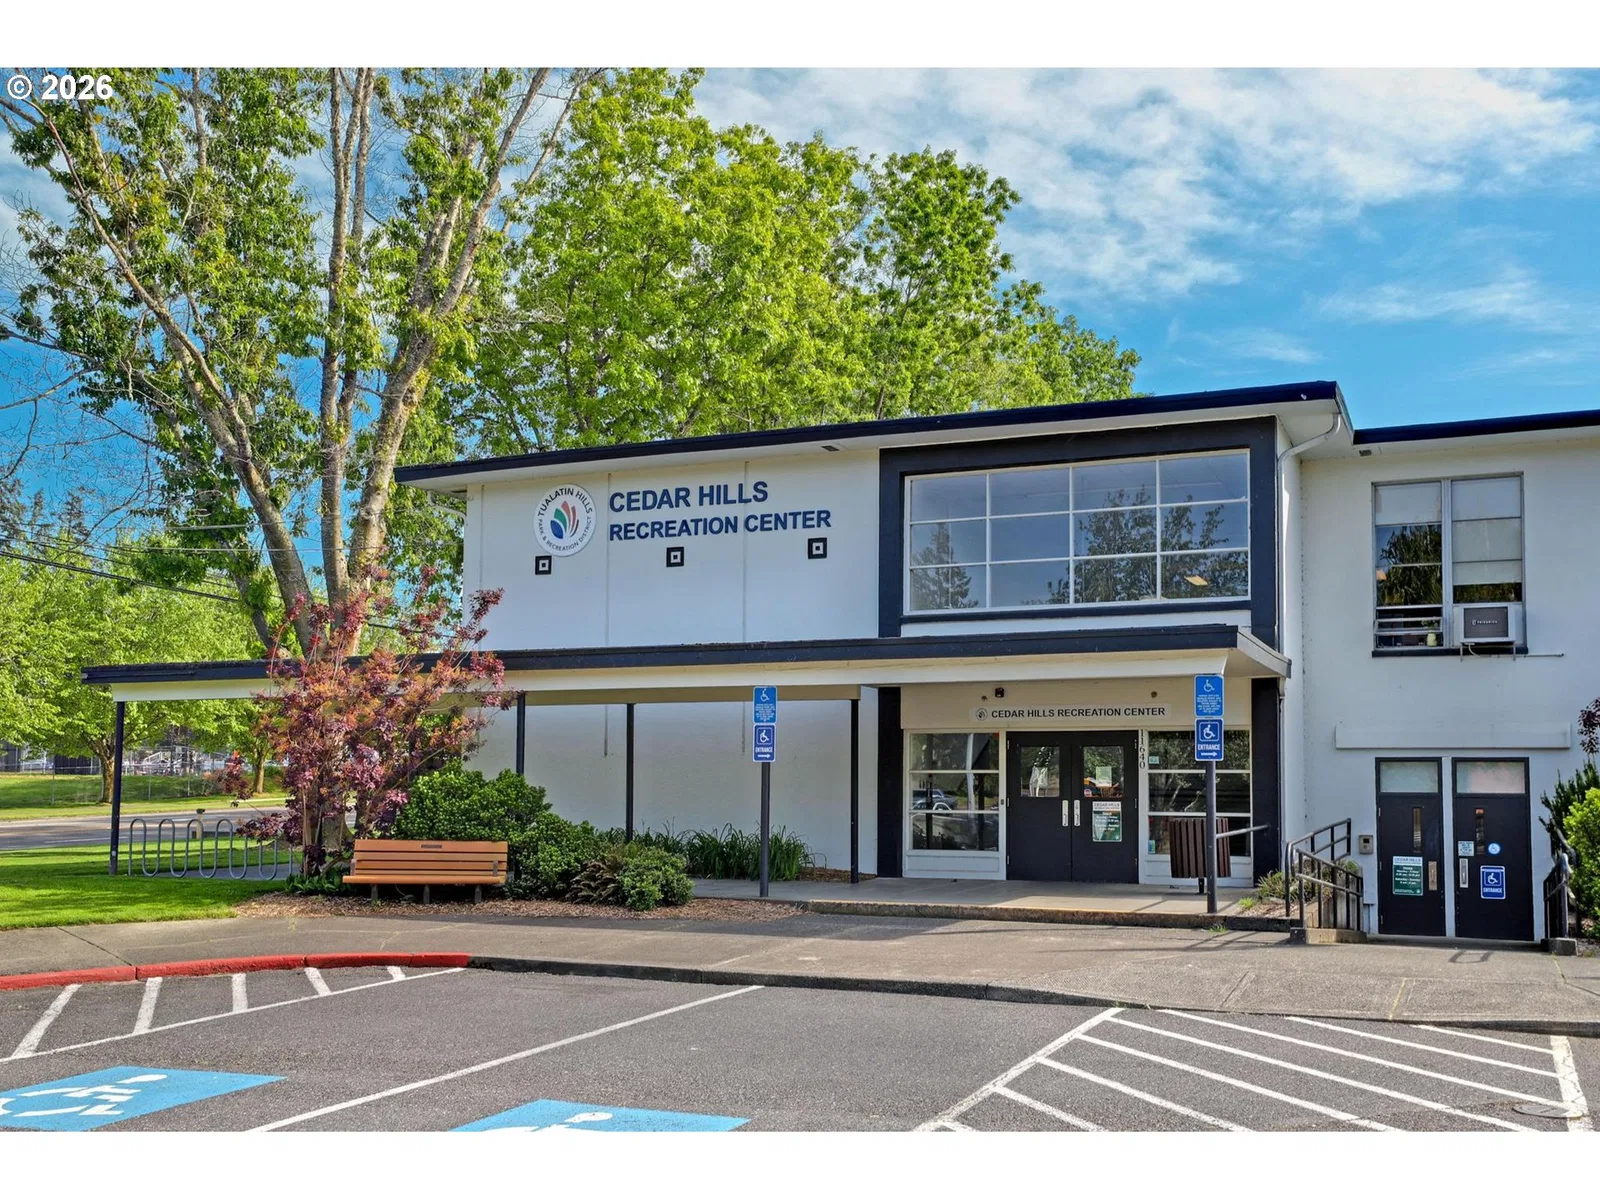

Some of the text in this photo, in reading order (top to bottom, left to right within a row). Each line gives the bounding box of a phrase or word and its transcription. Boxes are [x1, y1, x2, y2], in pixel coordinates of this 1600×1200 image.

[537, 487, 593, 517] TUALATIN HILLS
[609, 481, 768, 513] CEDAR HILLS
[546, 539, 579, 552] RECREATION
[578, 516, 592, 542] DISTRICT
[609, 509, 831, 541] RECREATION CENTER
[991, 707, 1165, 718] CEDAR HILLS RECREATION CENTER
[1197, 743, 1221, 751] ENTRANCE
